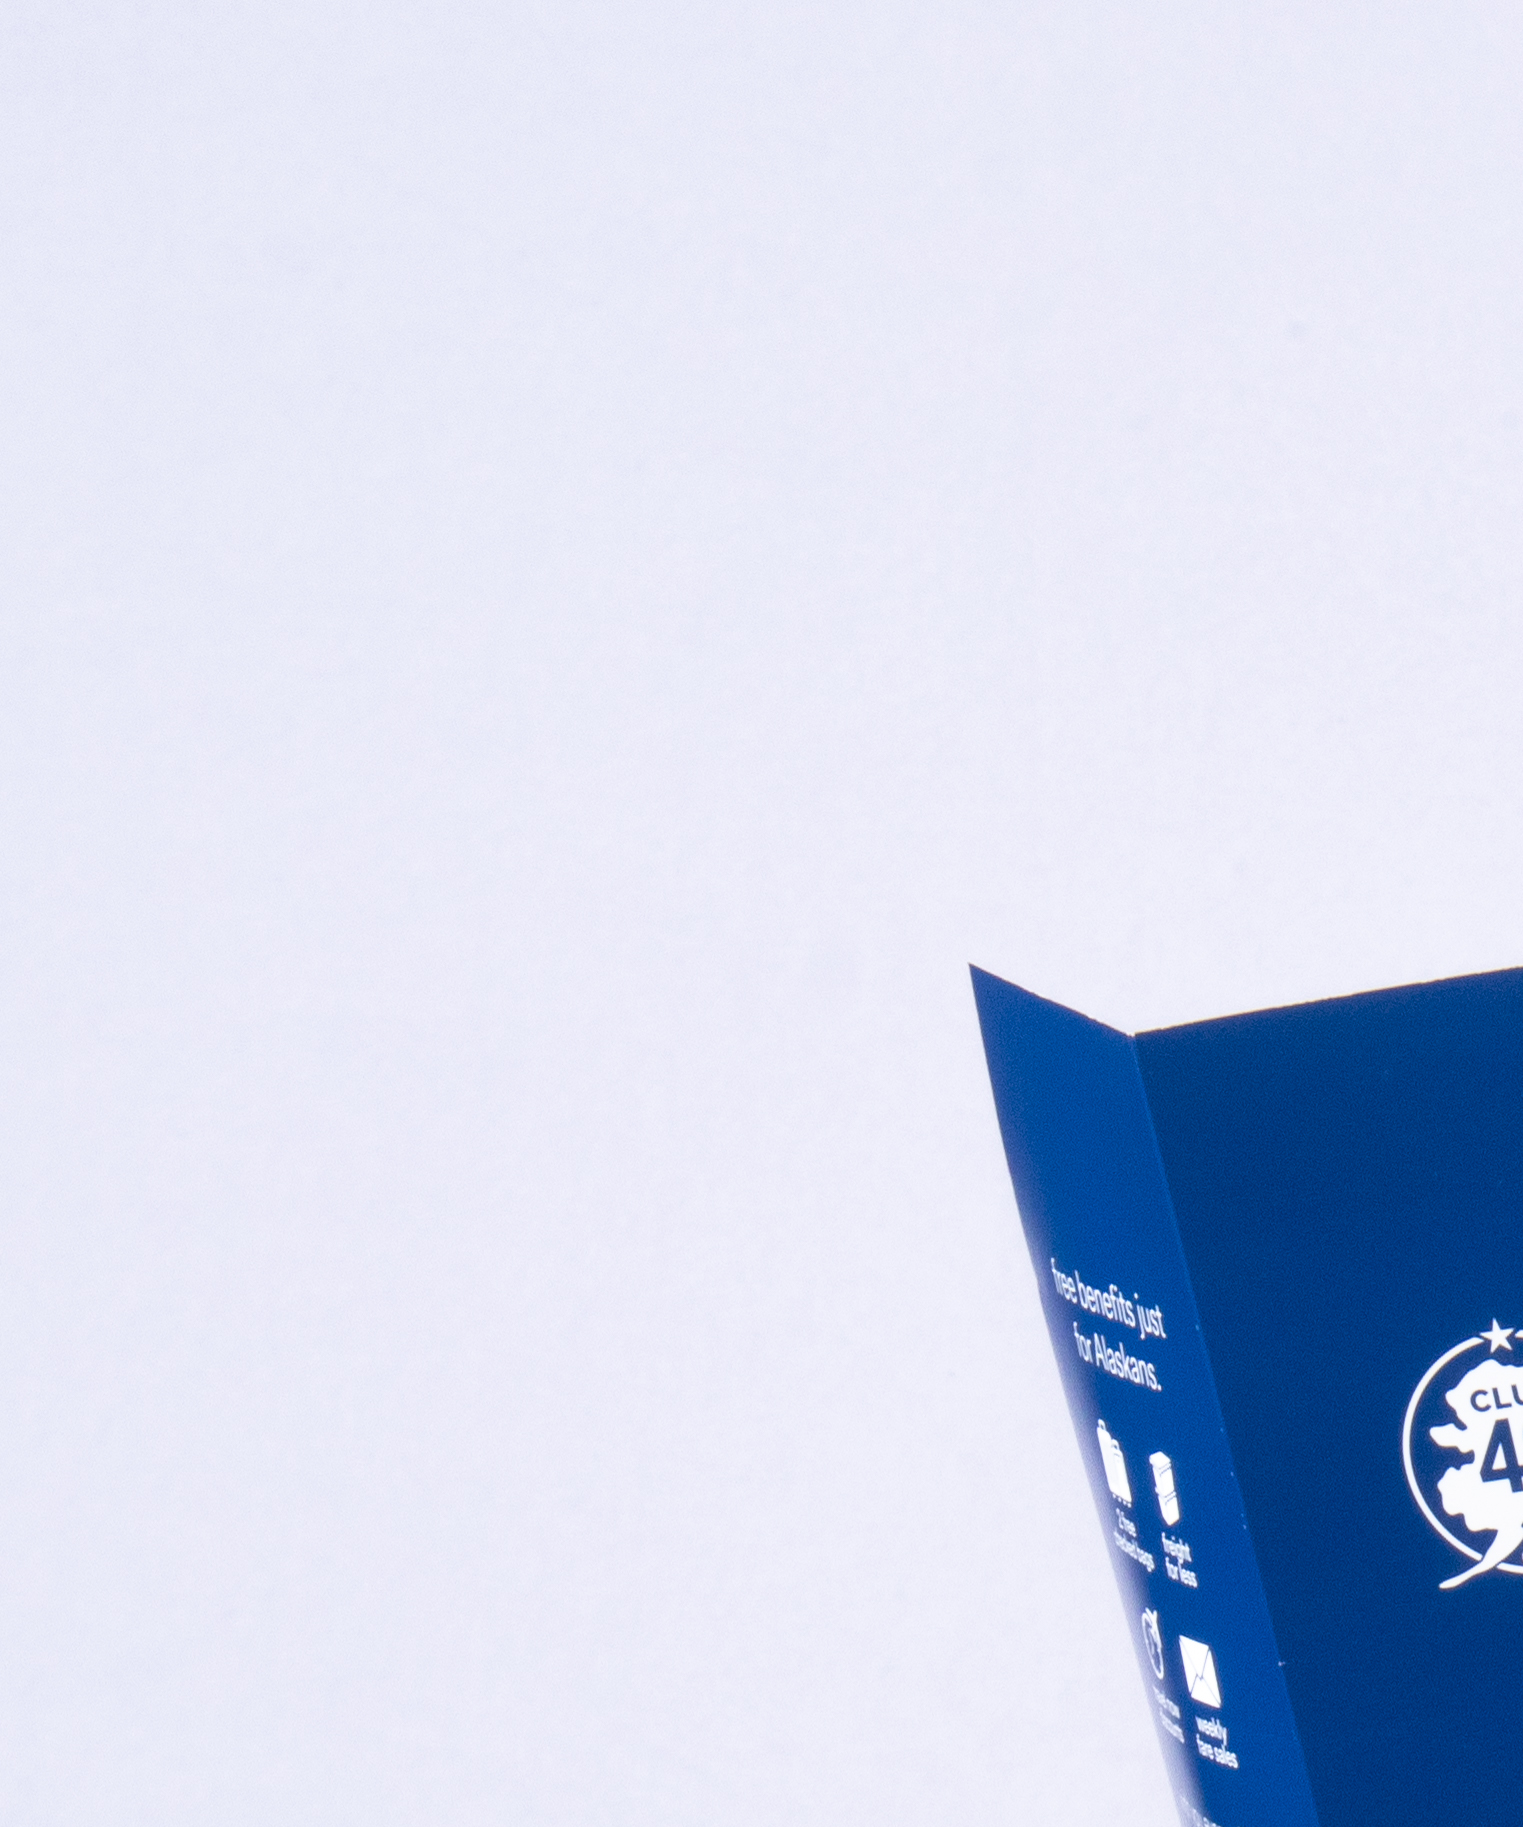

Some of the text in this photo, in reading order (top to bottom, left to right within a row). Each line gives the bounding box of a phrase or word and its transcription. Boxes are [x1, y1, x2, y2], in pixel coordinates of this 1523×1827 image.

[1051, 1257, 1167, 1340] free benefits just
[1073, 1321, 1162, 1391] for Alaskans.
[1161, 1531, 1192, 1565] freight
[1165, 1556, 1198, 1588] for less
[1195, 1715, 1227, 1747] weekly
[1196, 1733, 1239, 1769] fare sales
